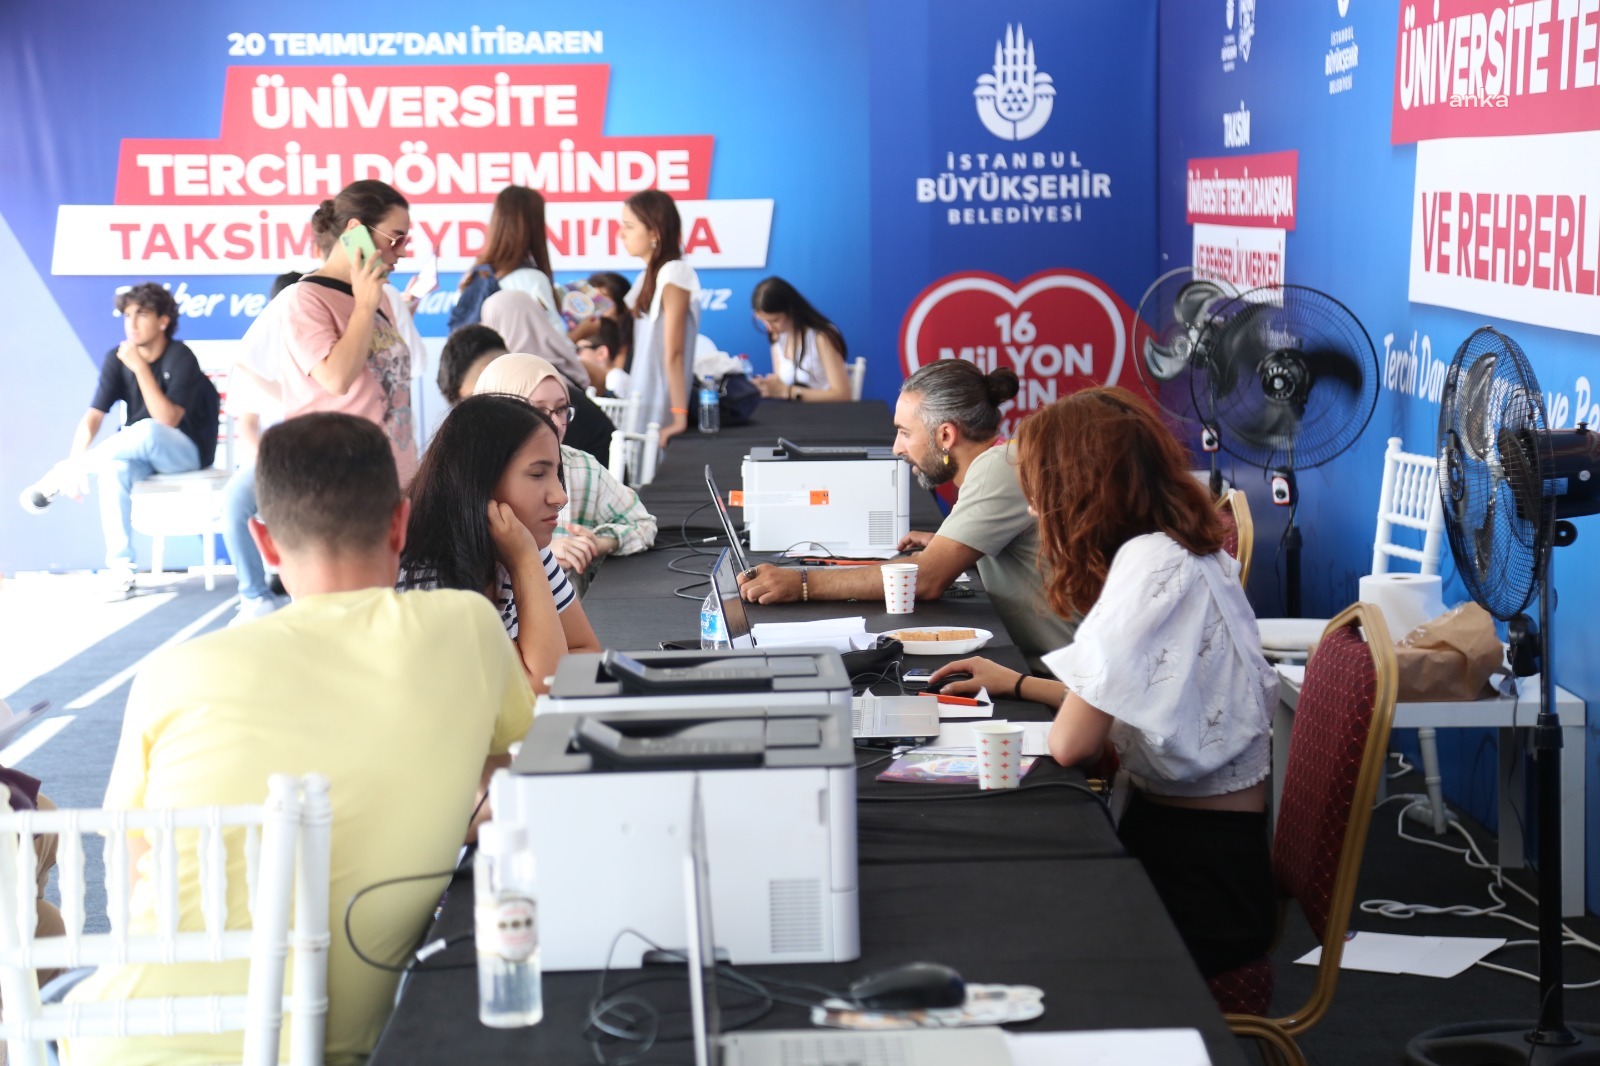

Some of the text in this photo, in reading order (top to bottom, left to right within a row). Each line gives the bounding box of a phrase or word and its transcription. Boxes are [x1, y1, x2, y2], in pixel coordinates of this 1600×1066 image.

[227, 25, 604, 57] 20 TEMMUZ'DAN İTİBAREN
[1400, 0, 1600, 111] ÜNİVERSİTE TE
[252, 72, 578, 130] ÜNİVERSİTE
[137, 139, 690, 197] TERCİH DÖNEMİNDE
[916, 169, 1112, 203] BÜYÜKŞEHİR
[947, 151, 1082, 171] İSTANBUL
[109, 210, 319, 260] TAKSİM
[947, 202, 1082, 225] BELEDİYESİ
[1422, 191, 1600, 297] VE REHBERL
[994, 311, 1037, 345] 16
[1383, 329, 1419, 398] Tercih
